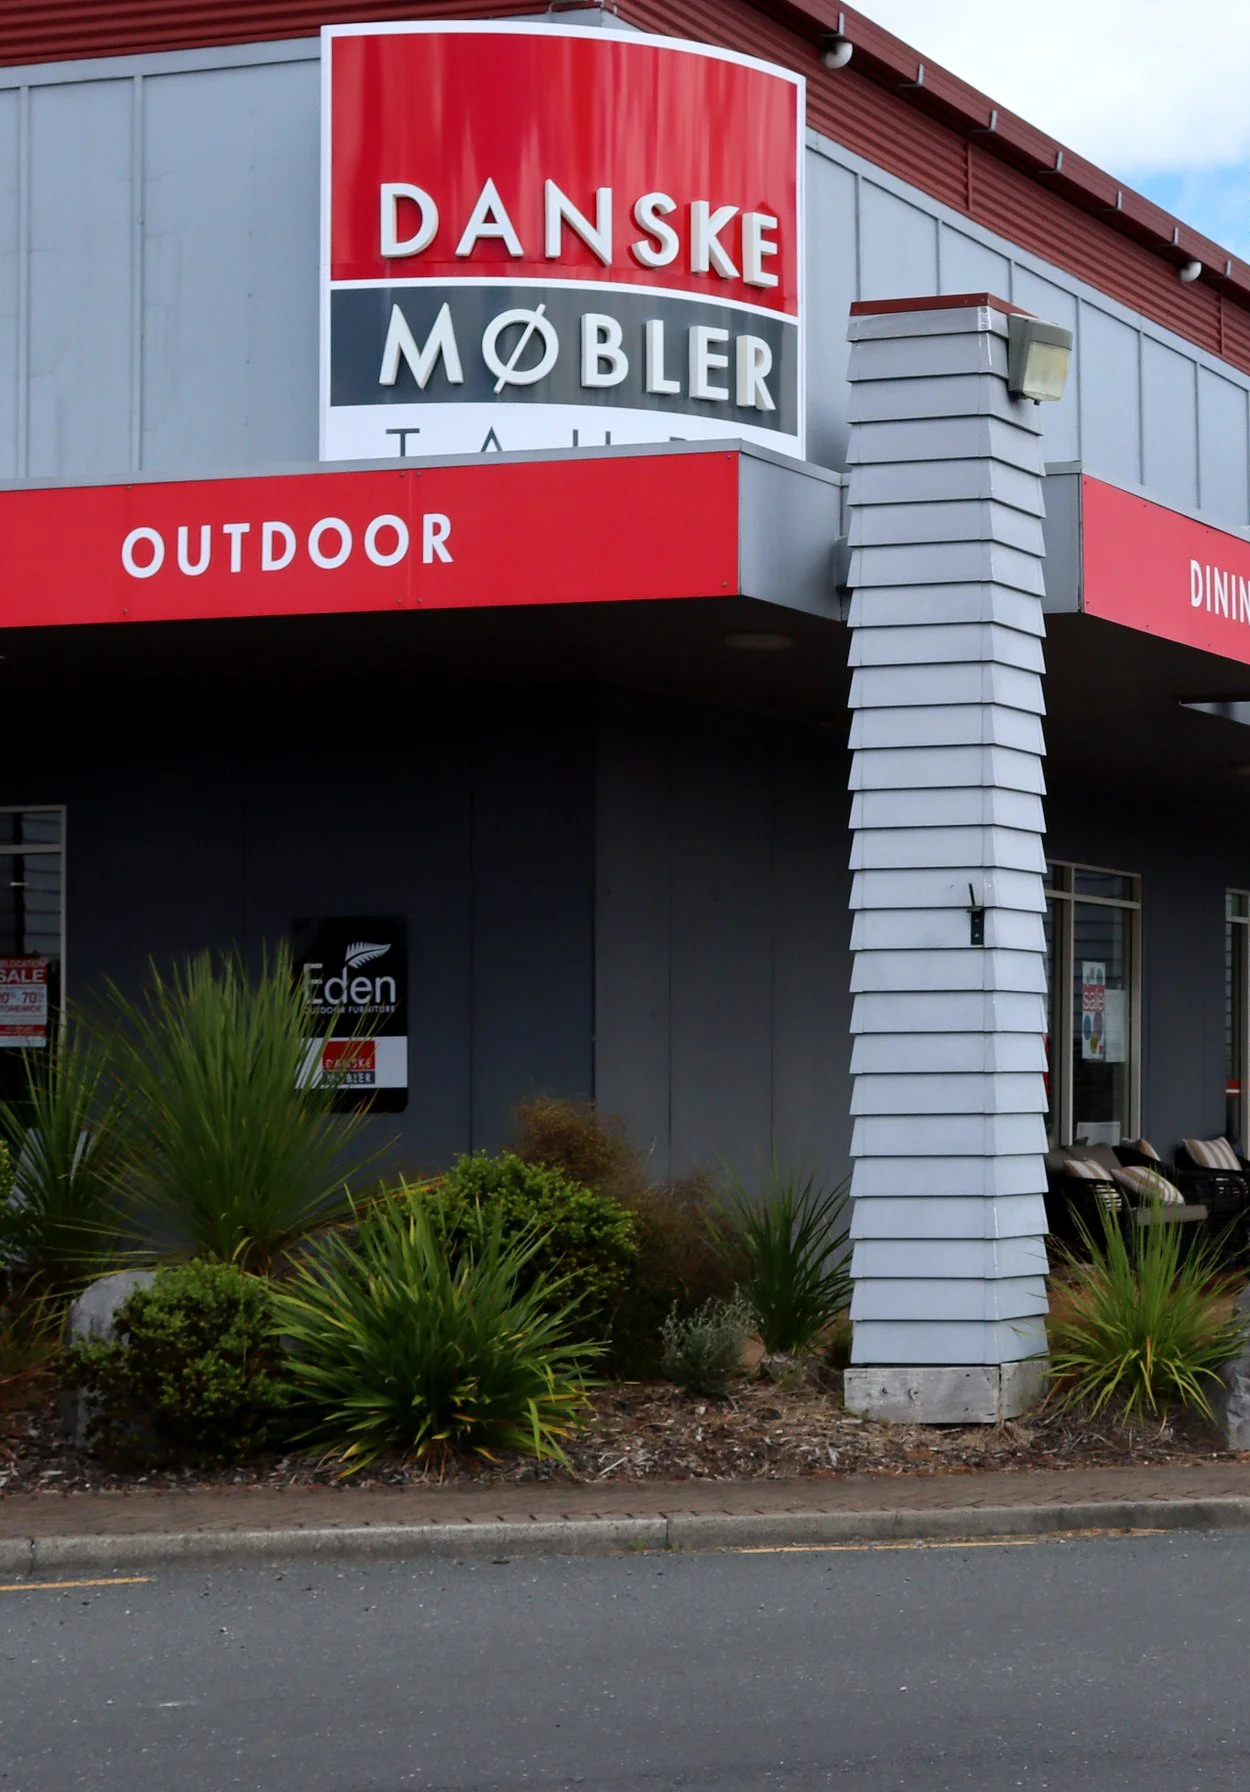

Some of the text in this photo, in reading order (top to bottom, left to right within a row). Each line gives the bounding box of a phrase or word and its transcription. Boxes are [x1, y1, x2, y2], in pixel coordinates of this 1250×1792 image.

[380, 177, 778, 288] DANSKE
[379, 302, 776, 410] MØBLER
[121, 513, 454, 578] OUTDOOR
[303, 963, 396, 1005] Eden
